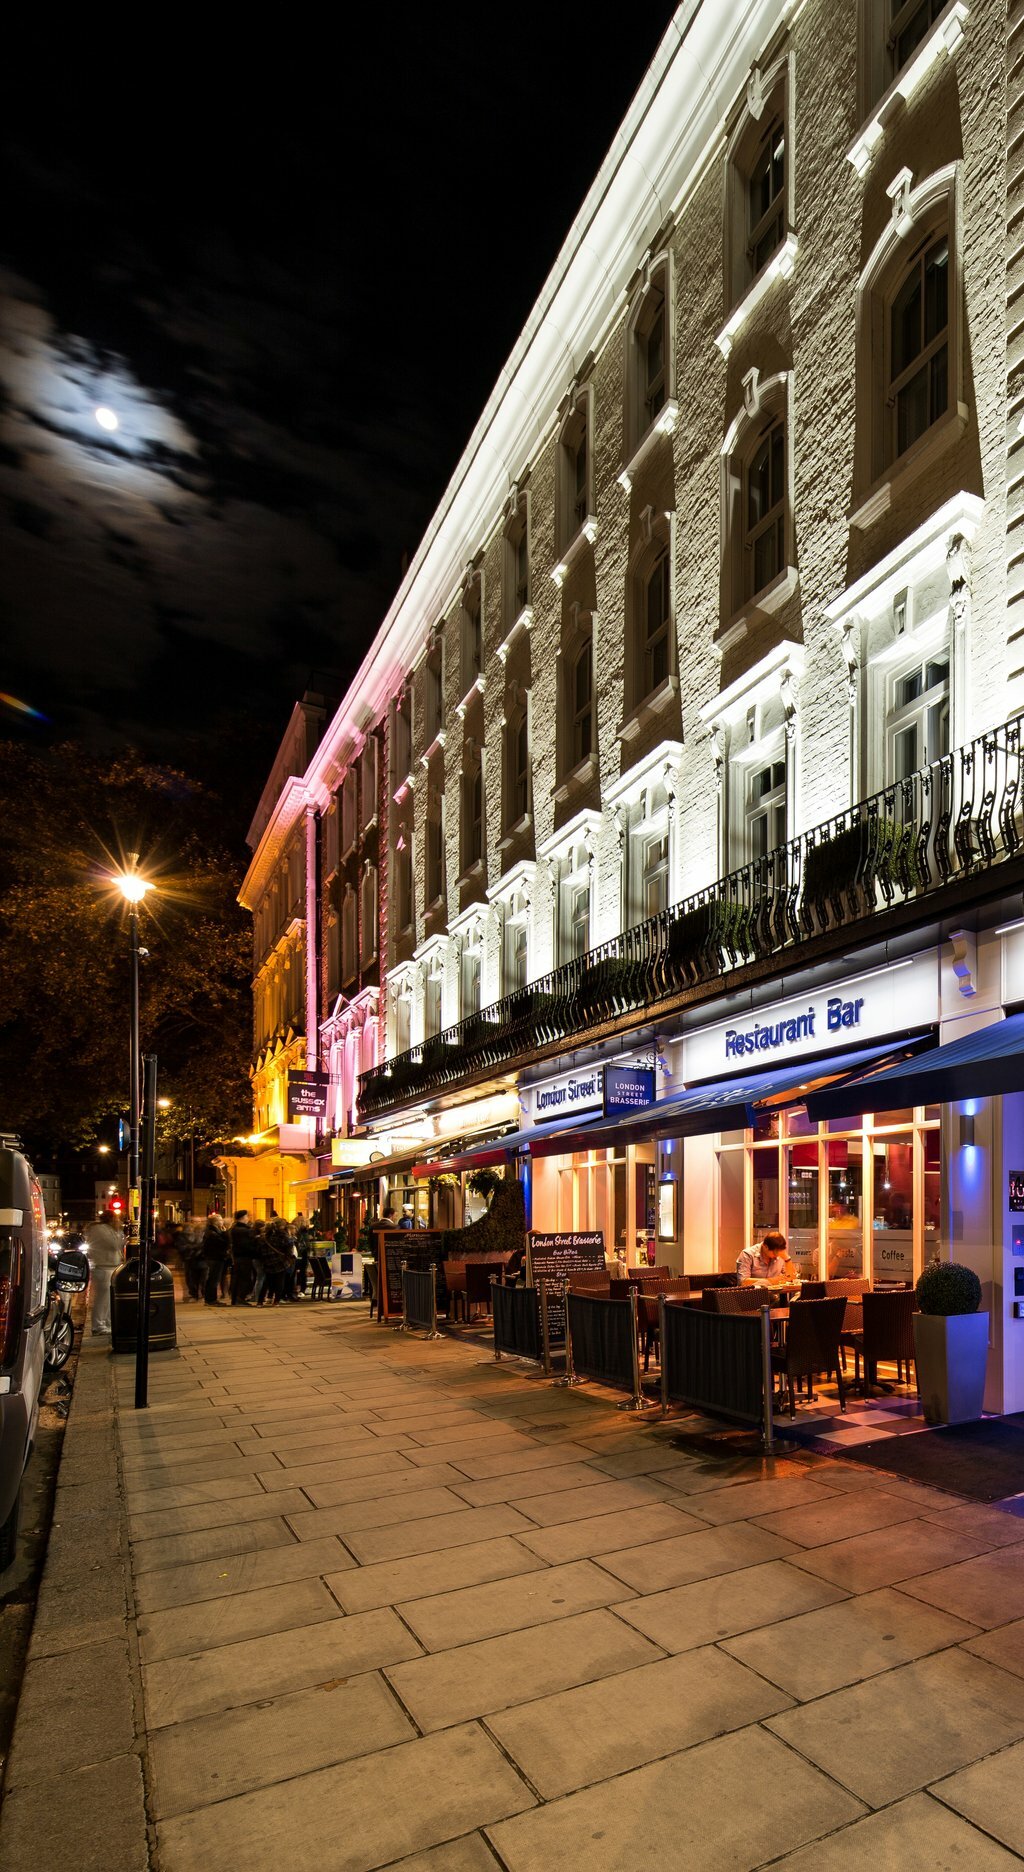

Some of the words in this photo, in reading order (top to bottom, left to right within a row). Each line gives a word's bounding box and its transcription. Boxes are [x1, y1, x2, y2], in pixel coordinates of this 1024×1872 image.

[725, 1006, 815, 1058] Restaurant
[827, 997, 864, 1030] Bar
[536, 1085, 566, 1110] London
[568, 1075, 597, 1100] Street
[615, 1082, 645, 1092] LONDON
[301, 1089, 316, 1098] the
[295, 1105, 321, 1113] arms
[531, 1236, 554, 1248] London
[554, 1235, 572, 1246] Street
[572, 1234, 602, 1246] Brasserie
[881, 1249, 905, 1261] Coffee
